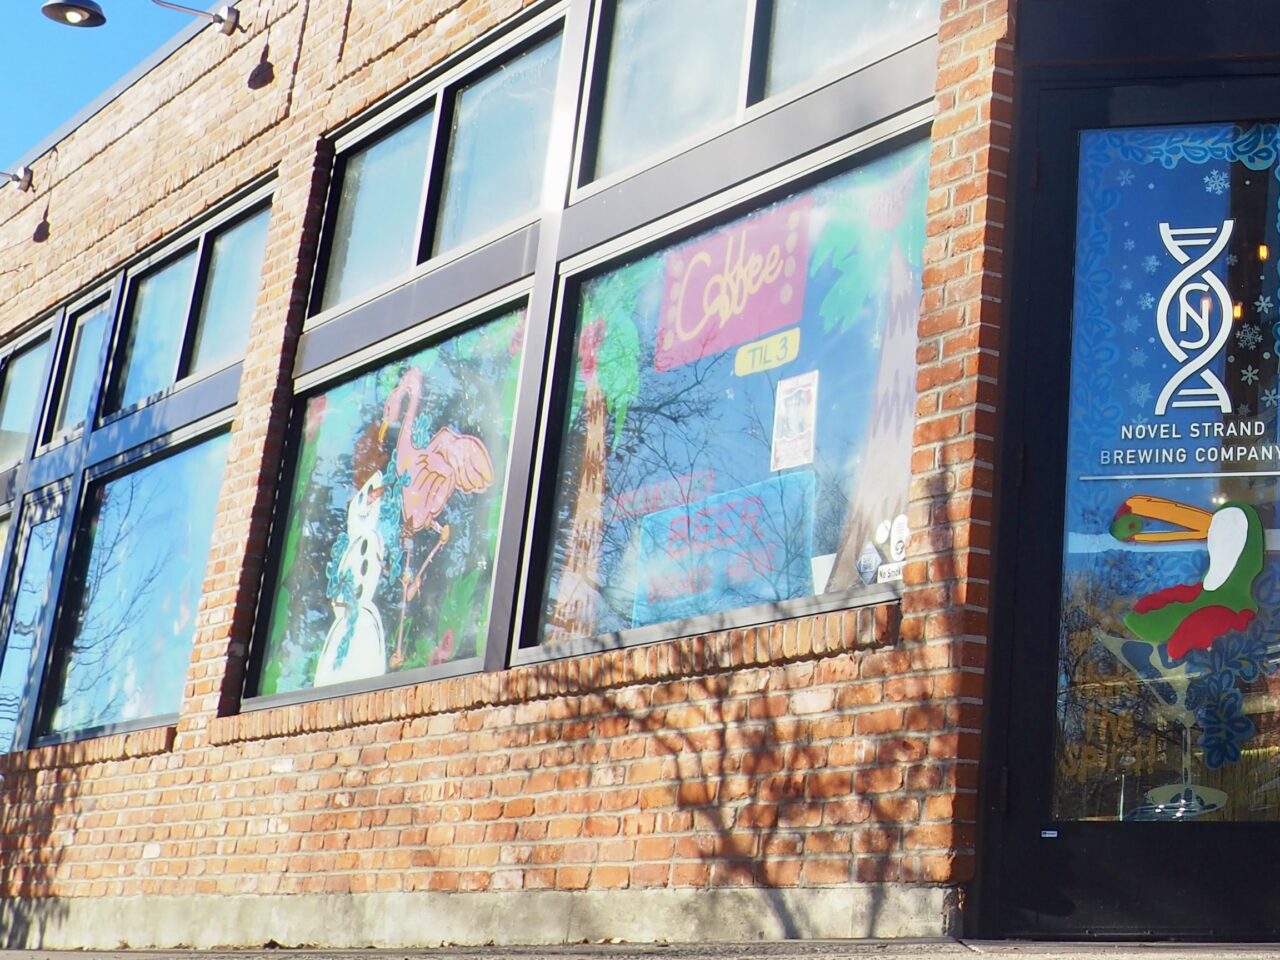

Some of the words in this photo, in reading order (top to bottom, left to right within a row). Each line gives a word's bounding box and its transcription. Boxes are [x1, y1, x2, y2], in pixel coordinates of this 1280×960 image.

[675, 229, 784, 342] Coffee
[747, 346, 772, 371] TIL
[776, 336, 788, 363] 3
[1121, 423, 1182, 440] NOVEL
[1190, 421, 1265, 438] STRAND
[1100, 448, 1187, 465] BREWING
[668, 496, 765, 560] BEER
